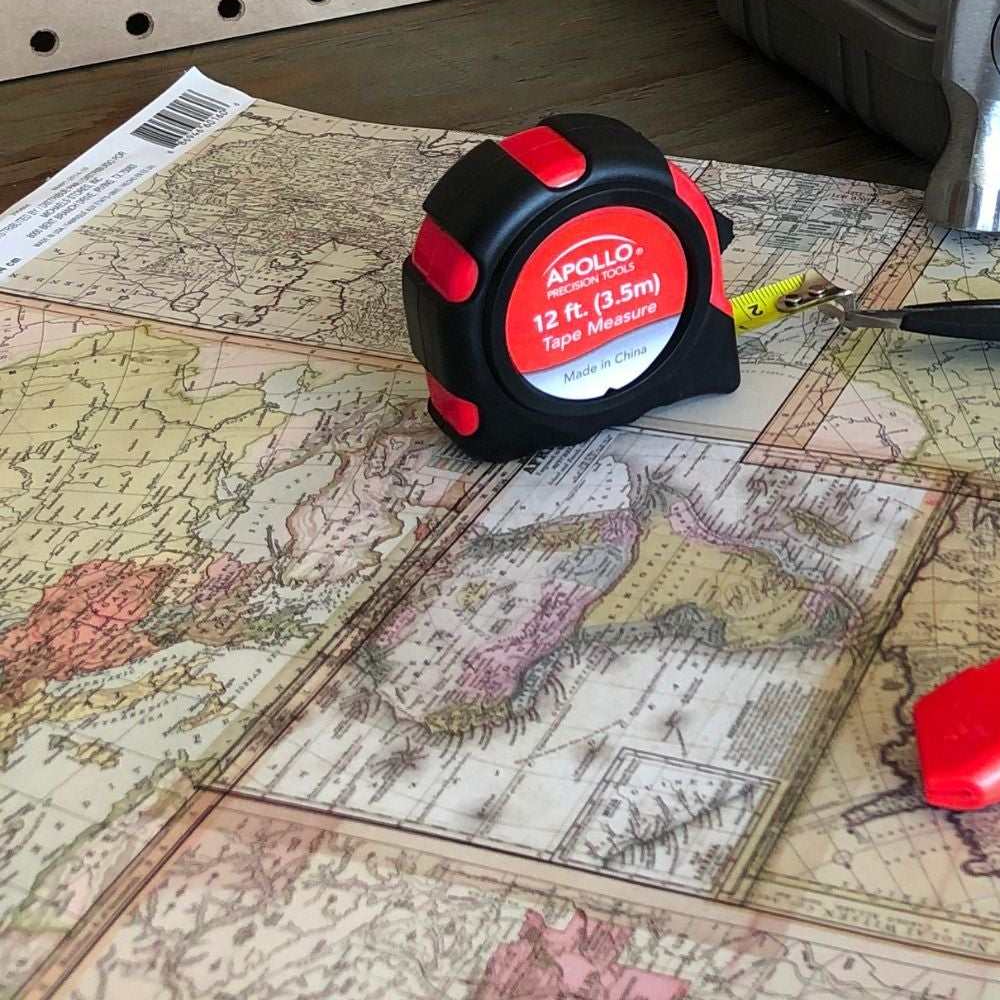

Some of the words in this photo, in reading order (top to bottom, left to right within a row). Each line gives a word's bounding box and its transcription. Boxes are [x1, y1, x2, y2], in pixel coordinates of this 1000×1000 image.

[547, 275, 599, 300] PRECISION
[602, 262, 636, 281] TOOLS
[533, 309, 560, 334] 12
[564, 302, 588, 323] ft.
[593, 272, 661, 318] (3.5m)
[747, 304, 764, 316] 2
[543, 329, 582, 352] Tape
[587, 302, 657, 336] Measure
[563, 364, 598, 385] Made
[601, 355, 611, 370] in
[614, 345, 647, 364] China
